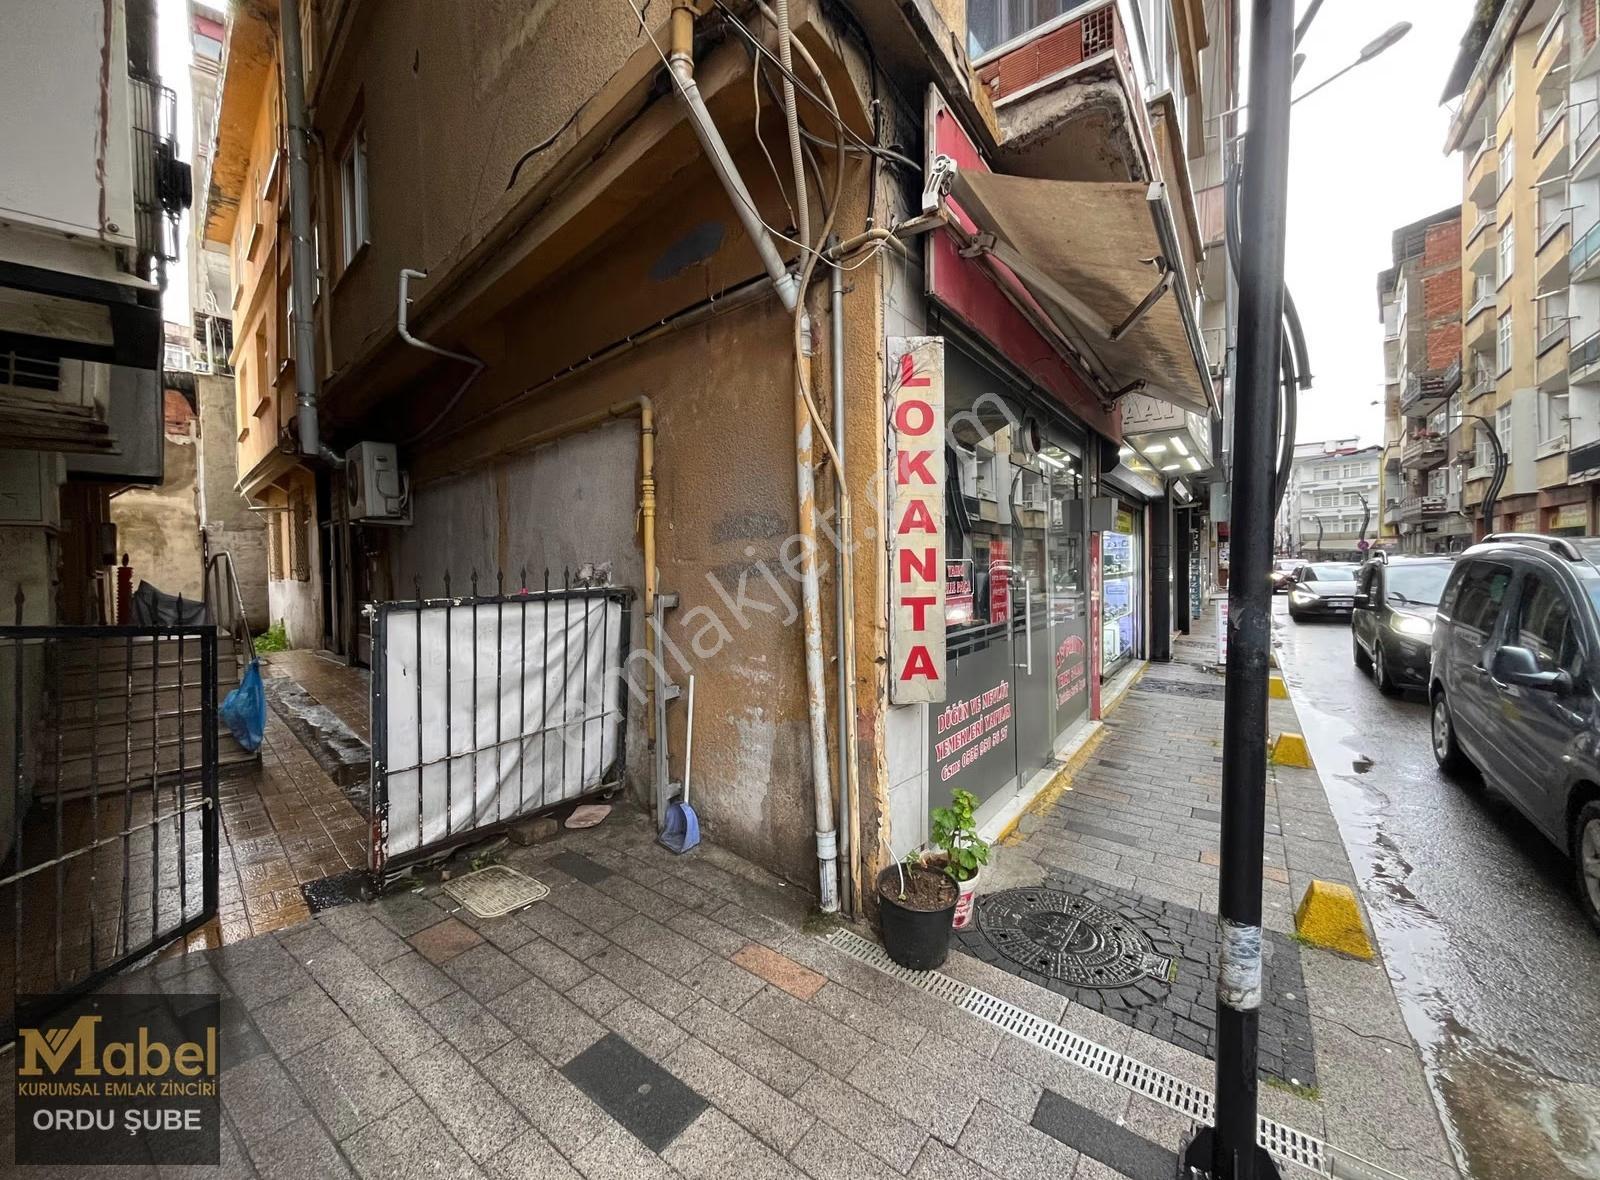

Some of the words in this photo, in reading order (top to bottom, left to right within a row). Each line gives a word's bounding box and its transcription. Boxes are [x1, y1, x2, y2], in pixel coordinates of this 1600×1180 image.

[895, 353, 939, 681] LOKANTA
[935, 714, 984, 762] YEMEKLERİ
[937, 700, 969, 735] DÜĞÜN
[970, 695, 981, 716] VE
